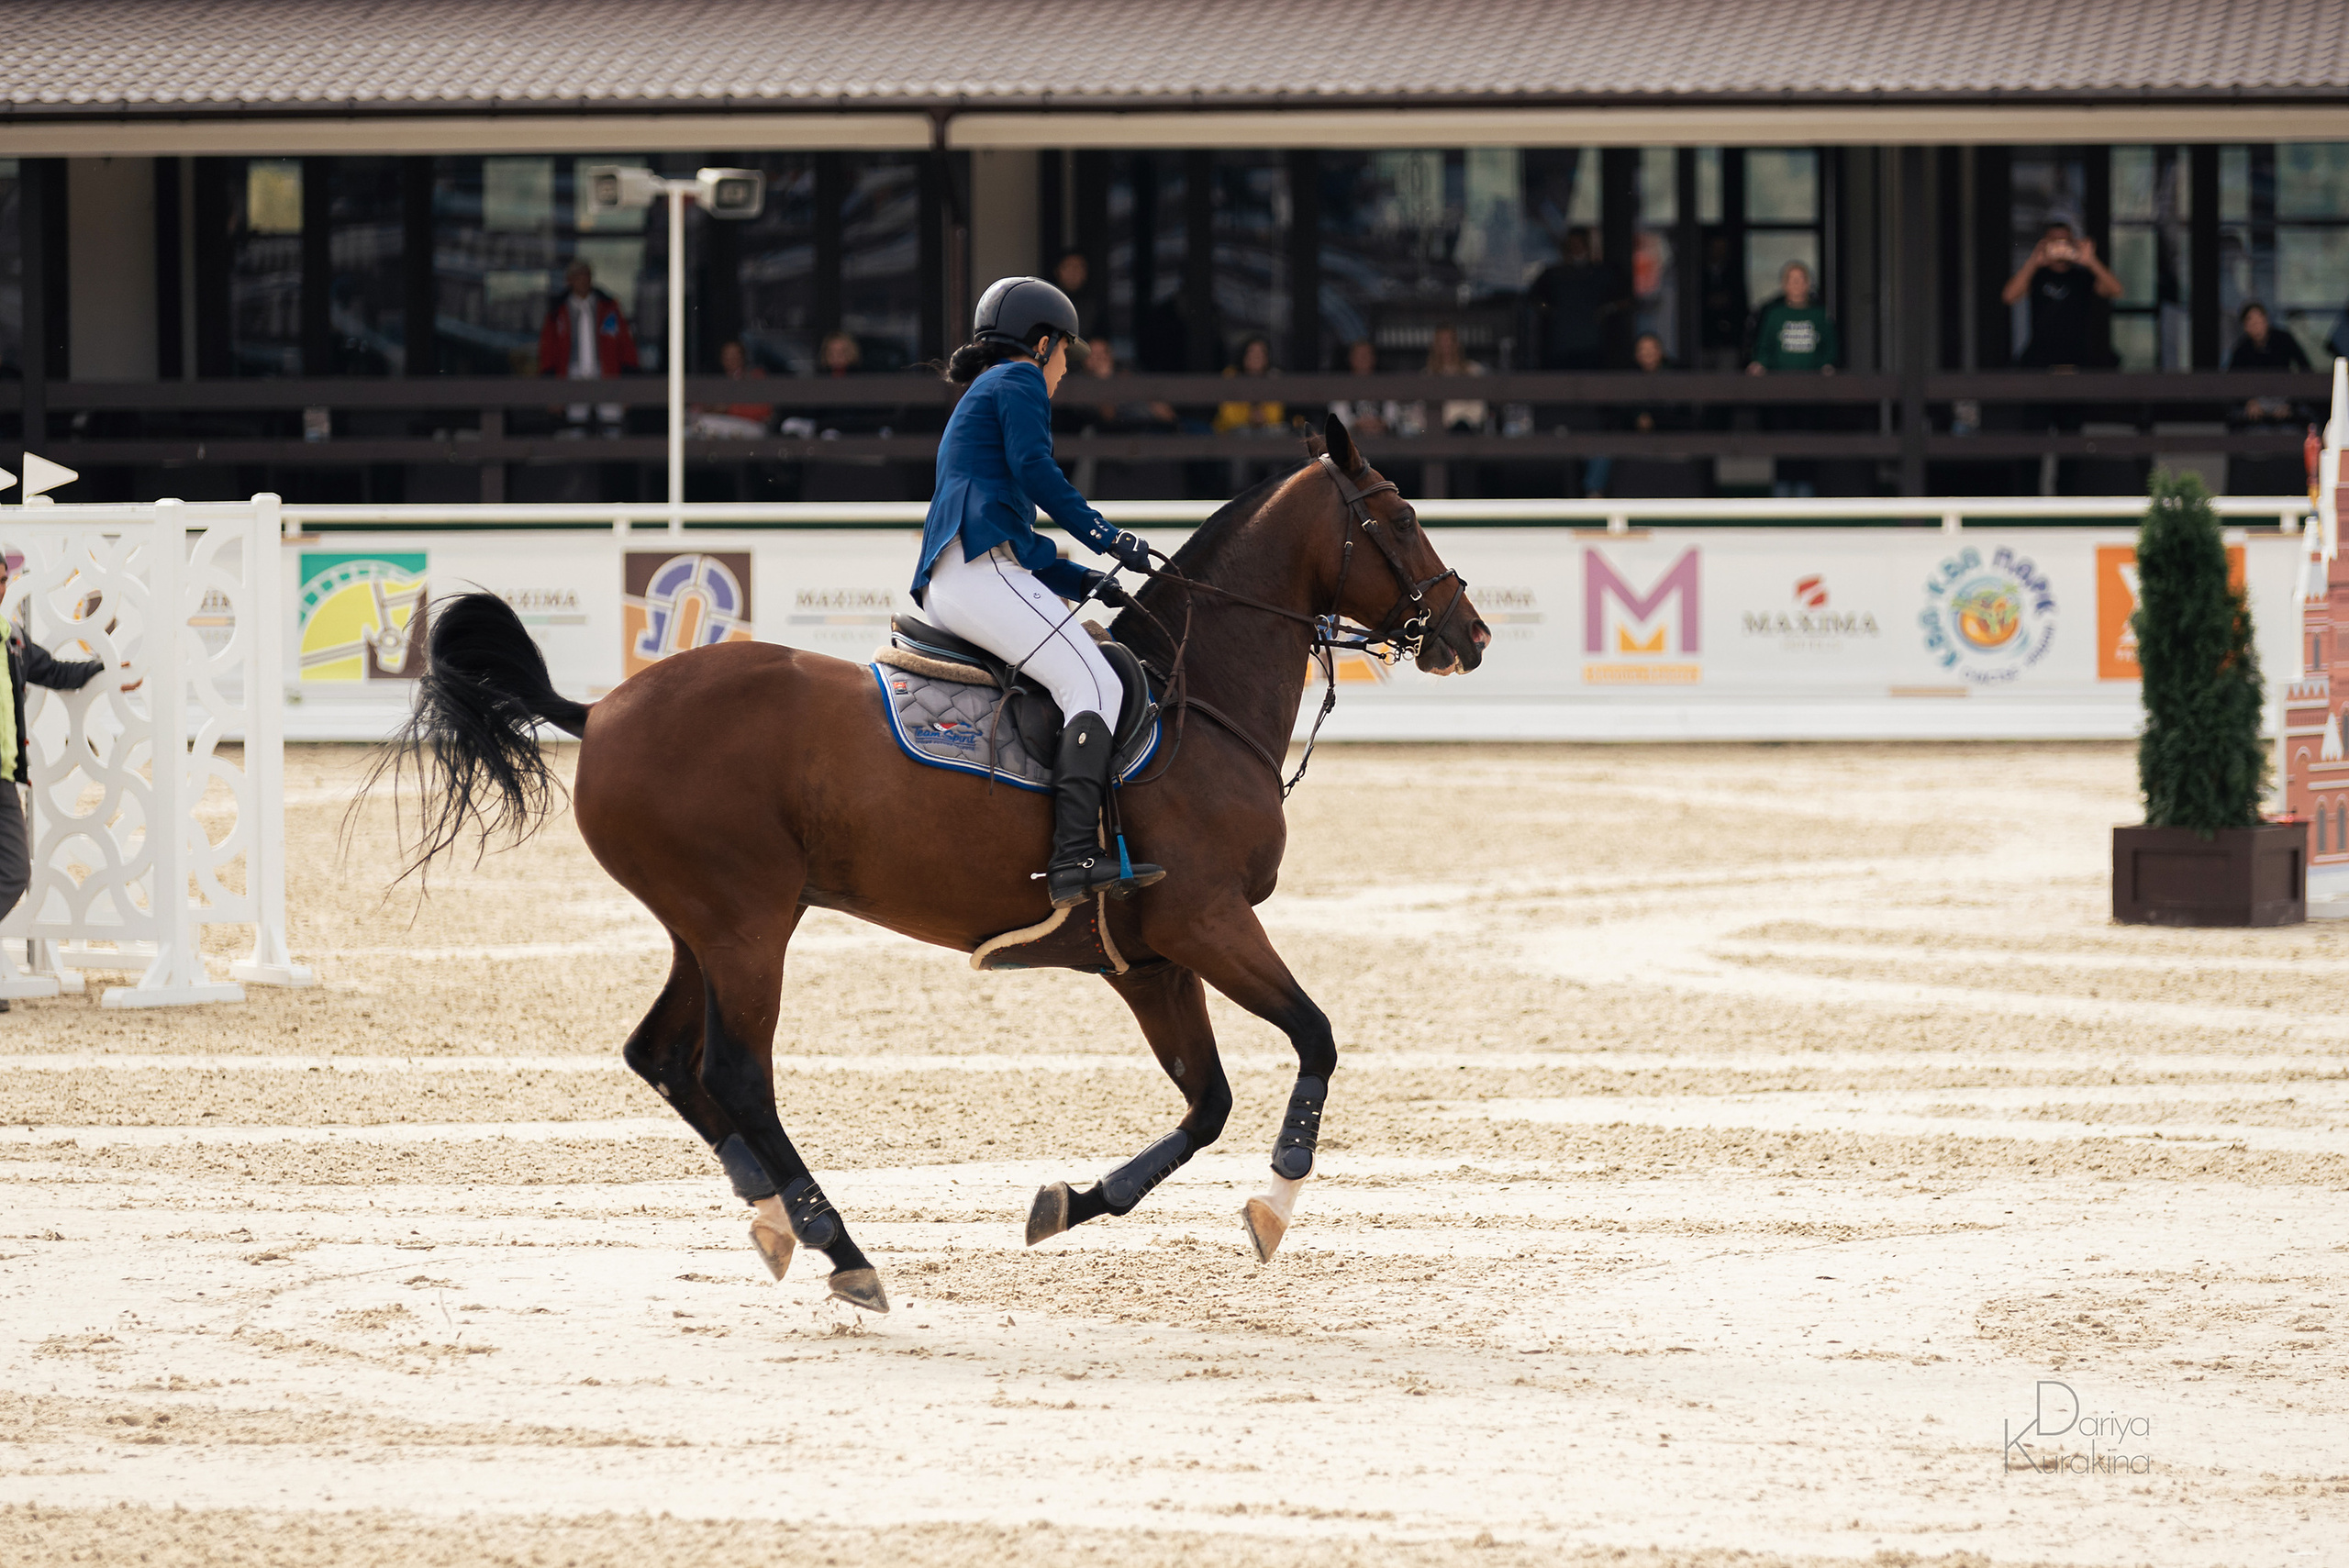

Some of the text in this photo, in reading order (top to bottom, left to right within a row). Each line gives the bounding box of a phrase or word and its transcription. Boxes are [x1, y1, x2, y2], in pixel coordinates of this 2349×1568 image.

[496, 589, 580, 609] AXIMA
[796, 588, 895, 607] MAXIMA
[1742, 612, 1879, 635] MAXIMA
[912, 726, 976, 744] Team Spirit
